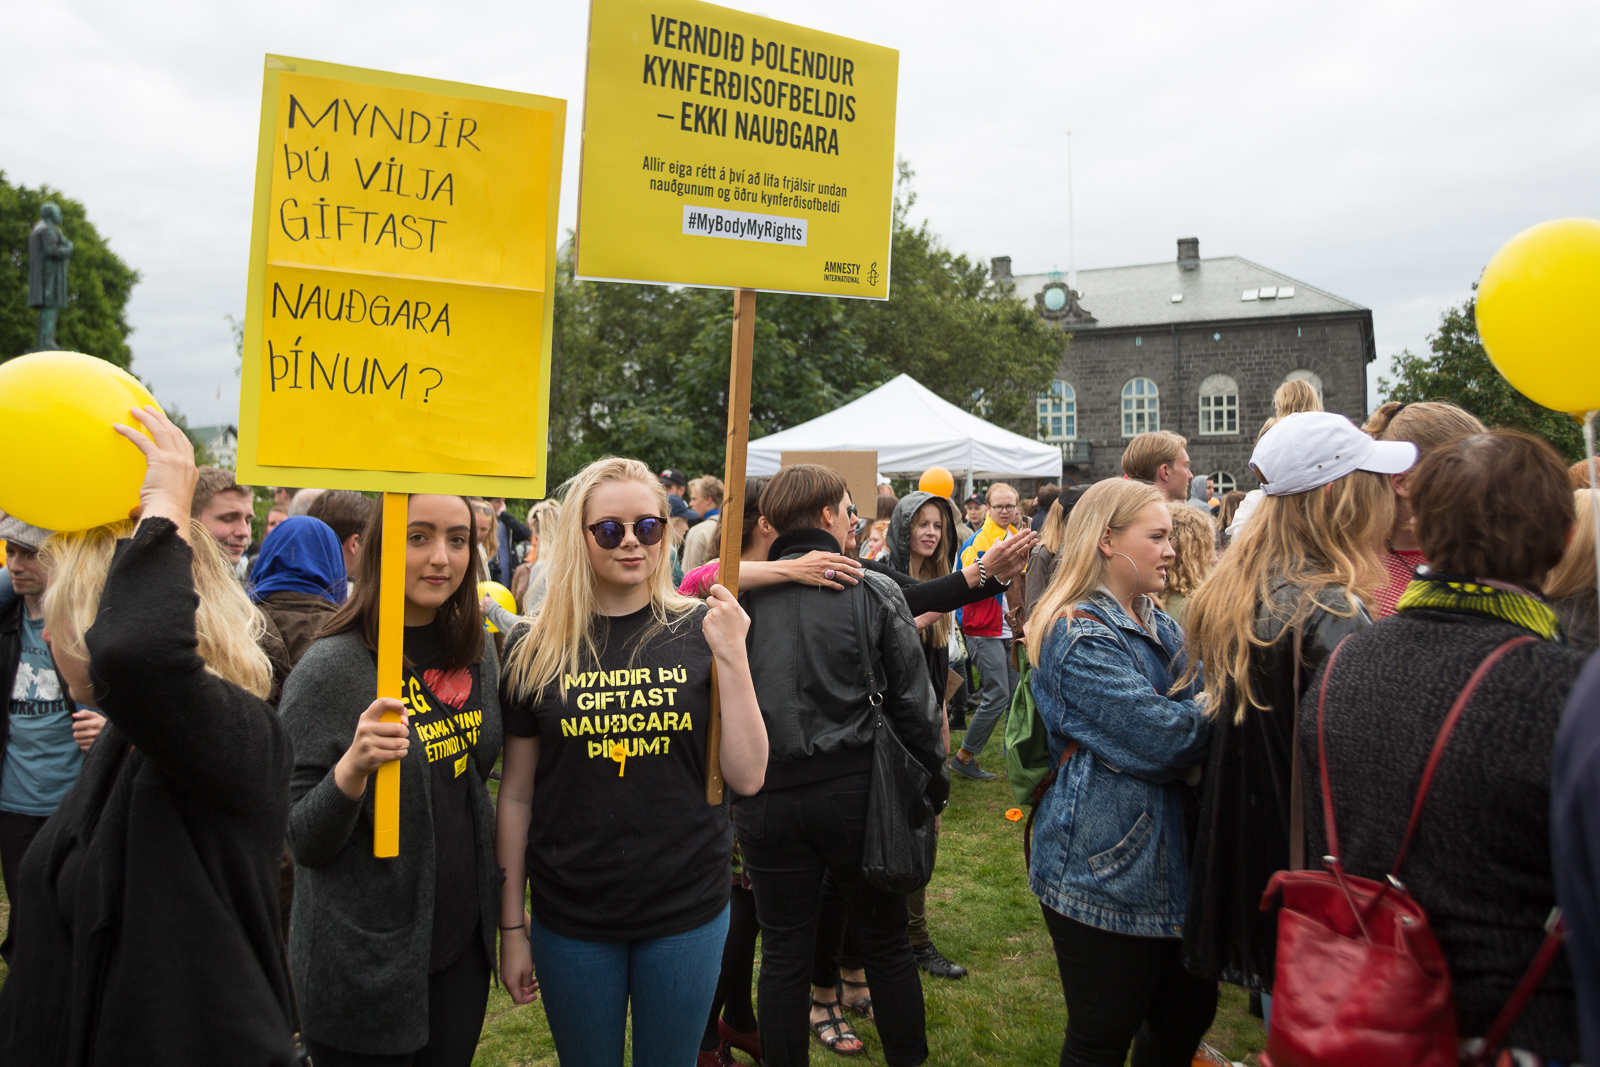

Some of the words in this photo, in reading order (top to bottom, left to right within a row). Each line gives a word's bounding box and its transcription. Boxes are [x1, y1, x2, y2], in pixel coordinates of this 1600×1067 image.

[650, 13, 745, 63] VERNDIÐ
[751, 37, 855, 87] ÞOLENDUR
[643, 53, 857, 123] KYNFERÐISOFBELDIS
[680, 101, 727, 138] EKKI
[735, 110, 840, 156] NAUÐGARA
[642, 155, 666, 173] Allir
[669, 162, 692, 178] eiga
[696, 164, 716, 180] rétt
[719, 166, 726, 181] á
[729, 168, 745, 184] því
[748, 172, 760, 186] að
[764, 173, 779, 188] lifa
[783, 176, 815, 193] frjálsir
[818, 182, 847, 198] undan
[650, 178, 714, 197] nauðgunum
[718, 187, 730, 202] og
[734, 187, 758, 203] öðru
[761, 191, 840, 214] kynferðisofbeldi
[688, 211, 803, 242] #MyBodyMyRights
[823, 274, 860, 284] INTERNATIONAL
[824, 261, 861, 275] AMNESTY
[272, 281, 450, 337] NAUÐGARA
[564, 667, 652, 690] MYNDIR
[658, 664, 688, 684] ÞÚ
[577, 687, 678, 711] GIFTAST
[560, 711, 693, 738] NAUÐGARA
